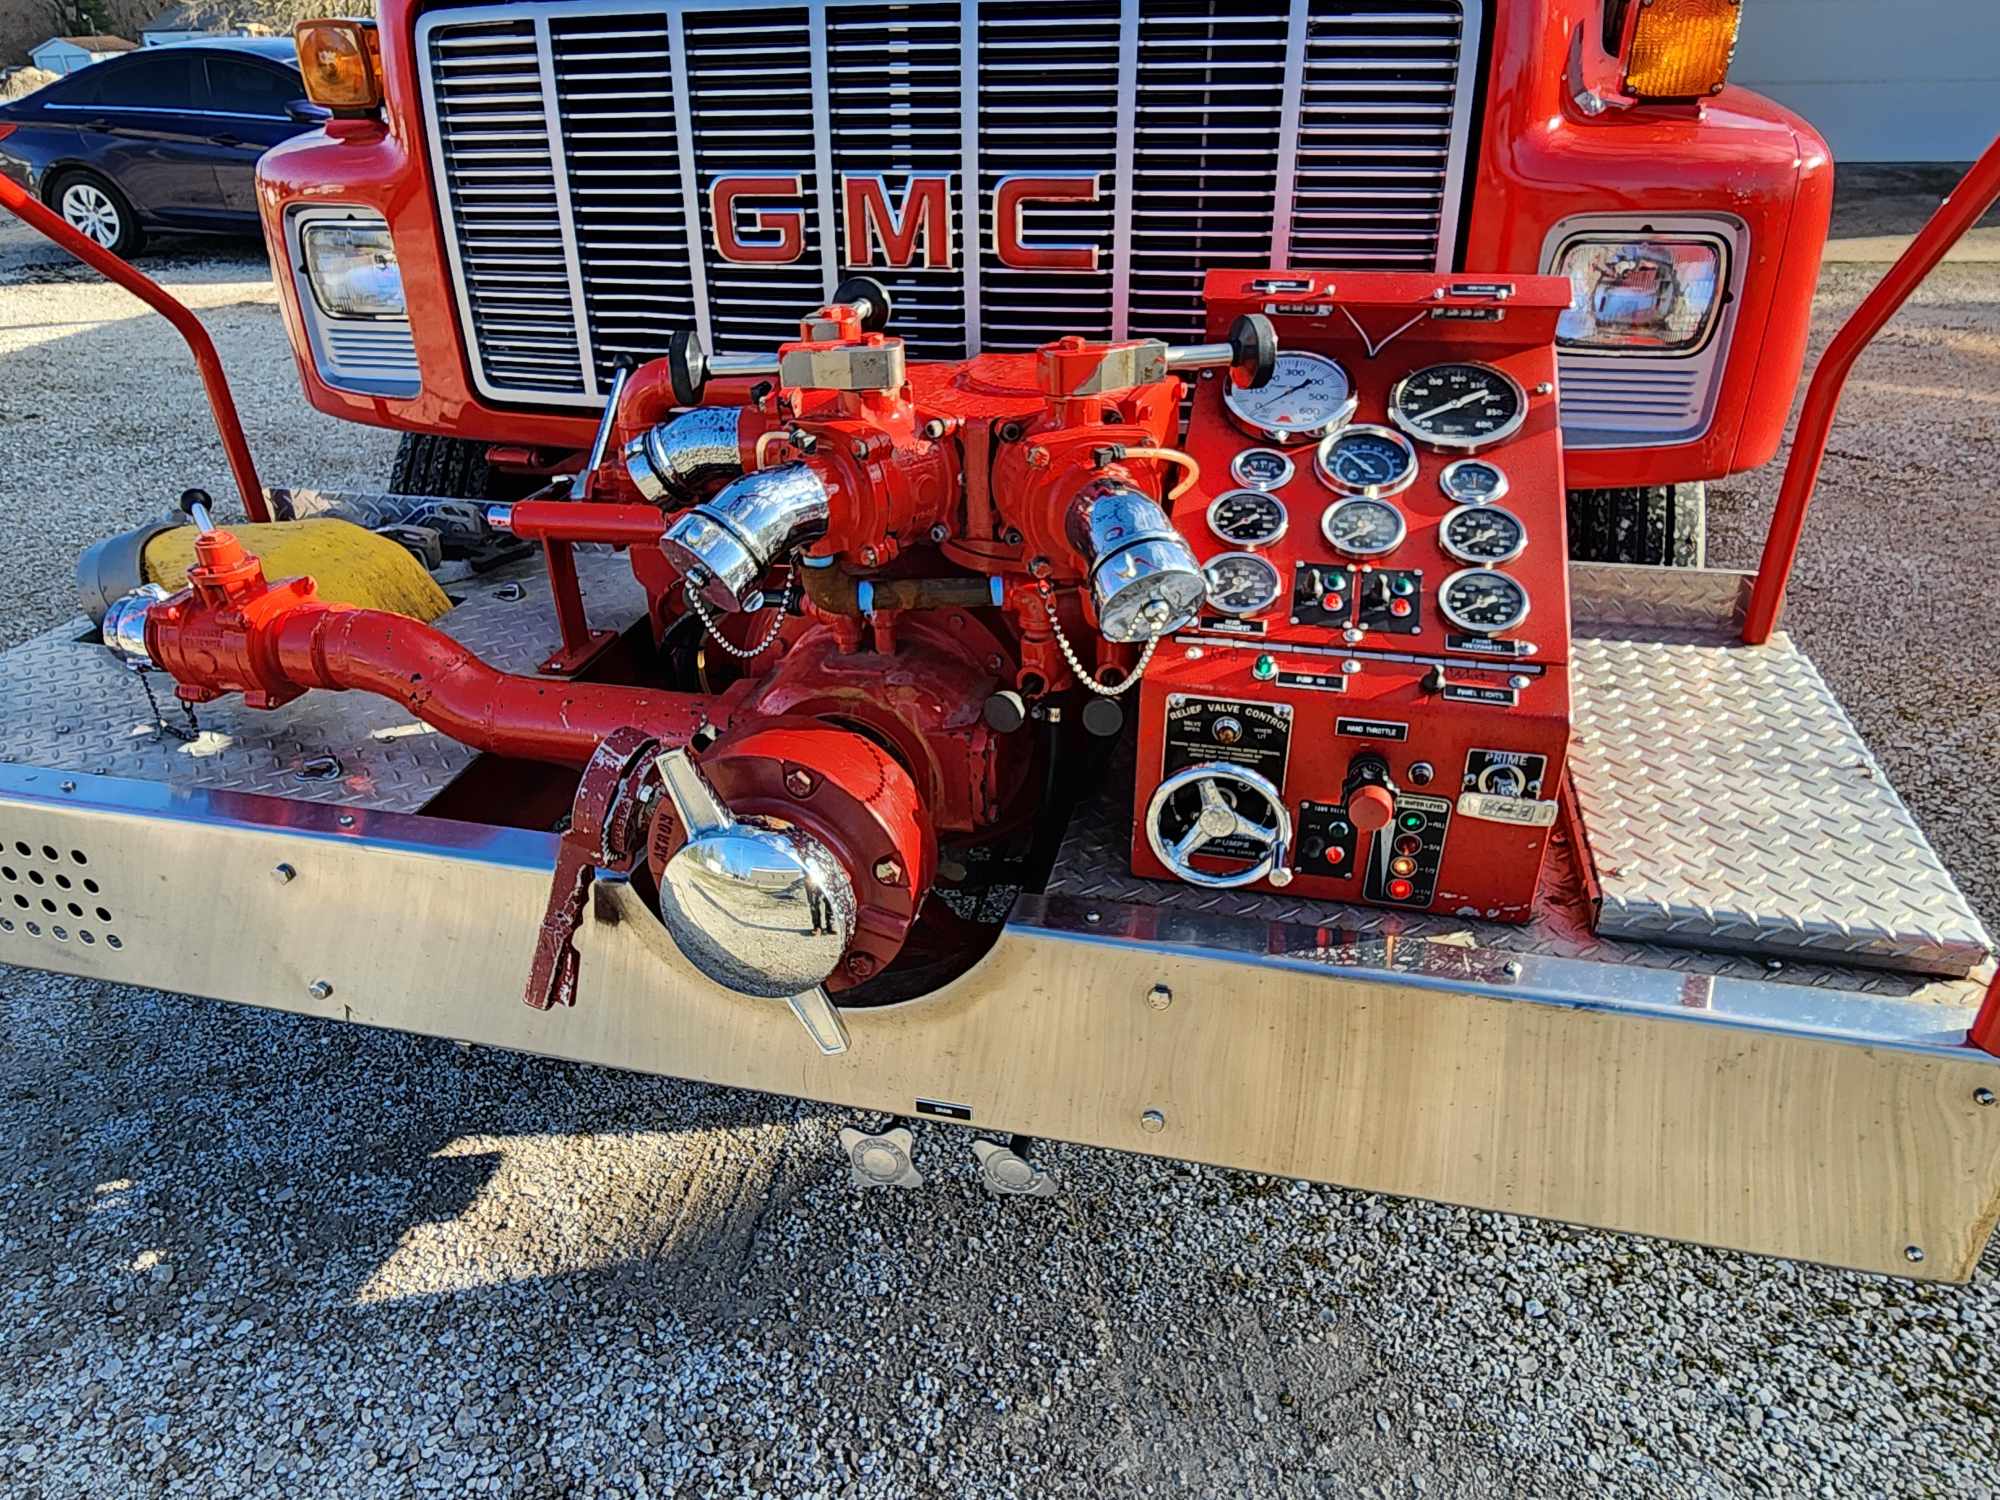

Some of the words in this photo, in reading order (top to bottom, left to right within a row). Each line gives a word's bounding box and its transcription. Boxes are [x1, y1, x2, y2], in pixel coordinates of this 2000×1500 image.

[709, 171, 1100, 271] GMC
[1285, 368, 1306, 377] 300
[1308, 392, 1329, 401] 500
[1299, 407, 1320, 416] 600
[1169, 704, 1202, 720] RELIEF
[1208, 703, 1240, 714] VALVE
[1245, 707, 1288, 733] CONTROL
[1366, 726, 1396, 736] THROTTLE
[1485, 752, 1528, 766] PRIME
[1403, 800, 1425, 808] WATER
[653, 813, 674, 864] AKRON
[1214, 839, 1250, 849] PUMPS
